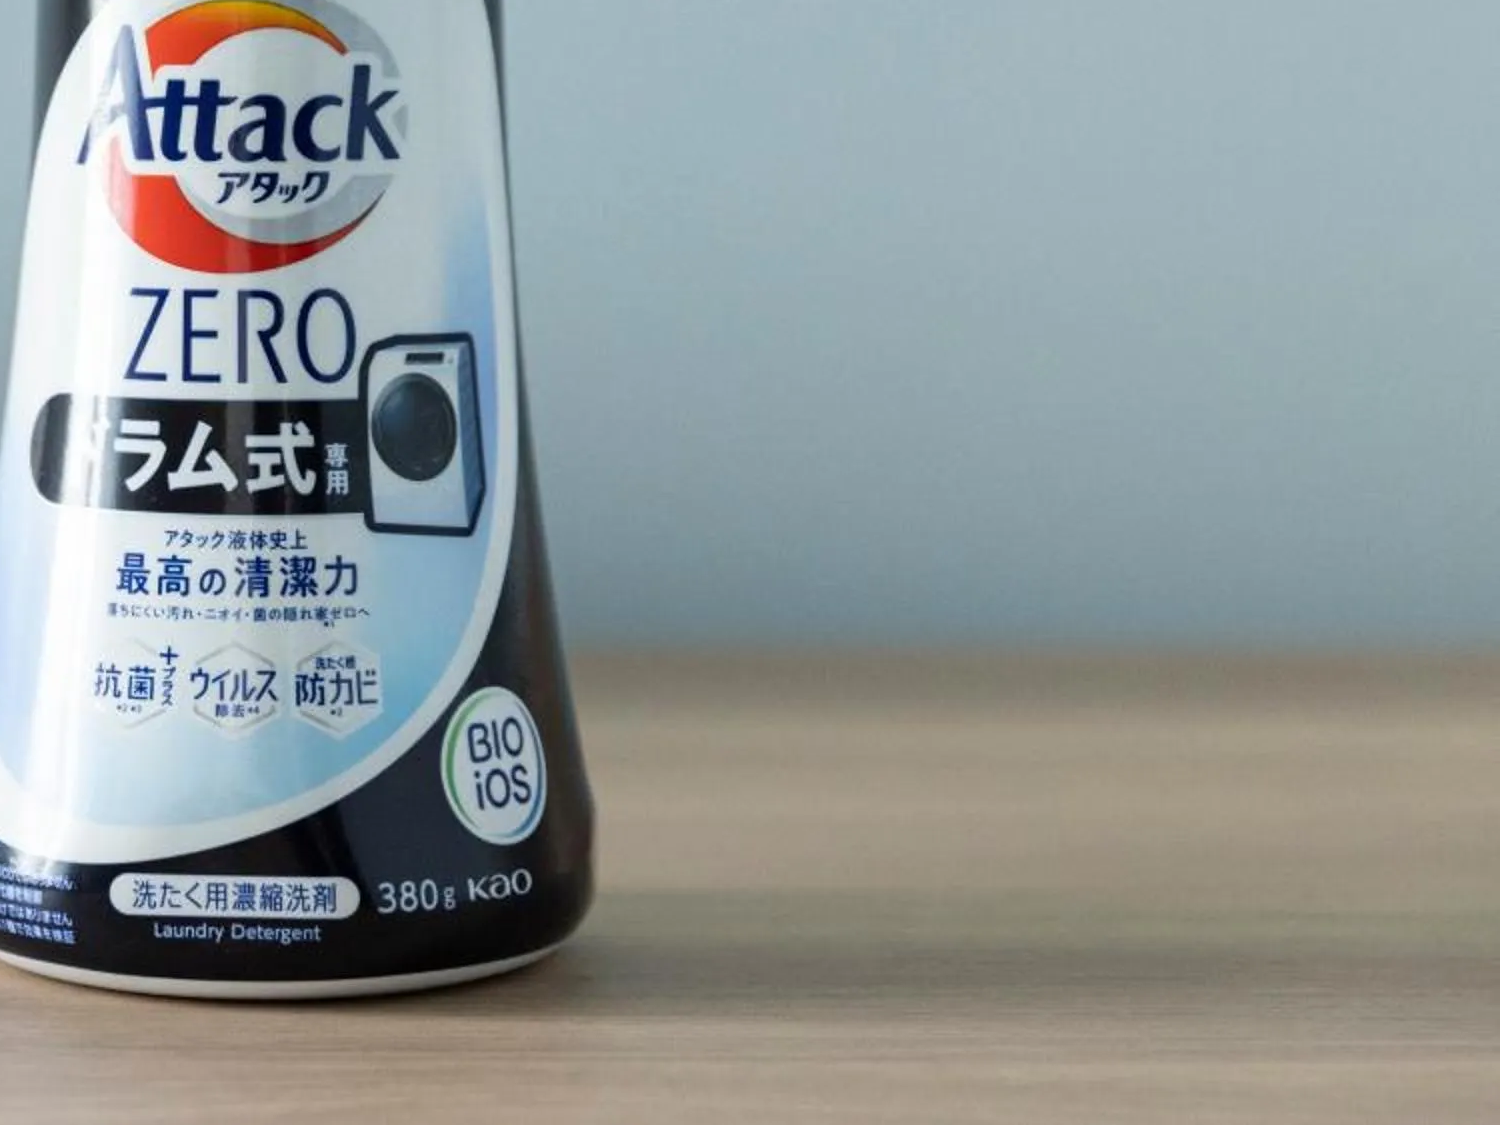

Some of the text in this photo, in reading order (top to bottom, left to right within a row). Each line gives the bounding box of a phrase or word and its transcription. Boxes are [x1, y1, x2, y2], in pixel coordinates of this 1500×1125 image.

[77, 25, 401, 165] Attack
[216, 171, 330, 205] アタック
[122, 287, 357, 385] ZERO
[88, 419, 317, 496] ラム式
[325, 442, 350, 496] 専用
[164, 528, 309, 551] アタック液体史上
[115, 552, 359, 598] 最高の清潔力
[93, 661, 157, 702] 抗菌
[189, 668, 280, 703] ウイルス
[294, 669, 380, 707] 防カビ
[467, 717, 524, 763] BIO
[474, 764, 531, 810] iOS
[132, 878, 337, 914] 洗たく用濃縮洗剤
[153, 921, 322, 945] Laundry Detergent
